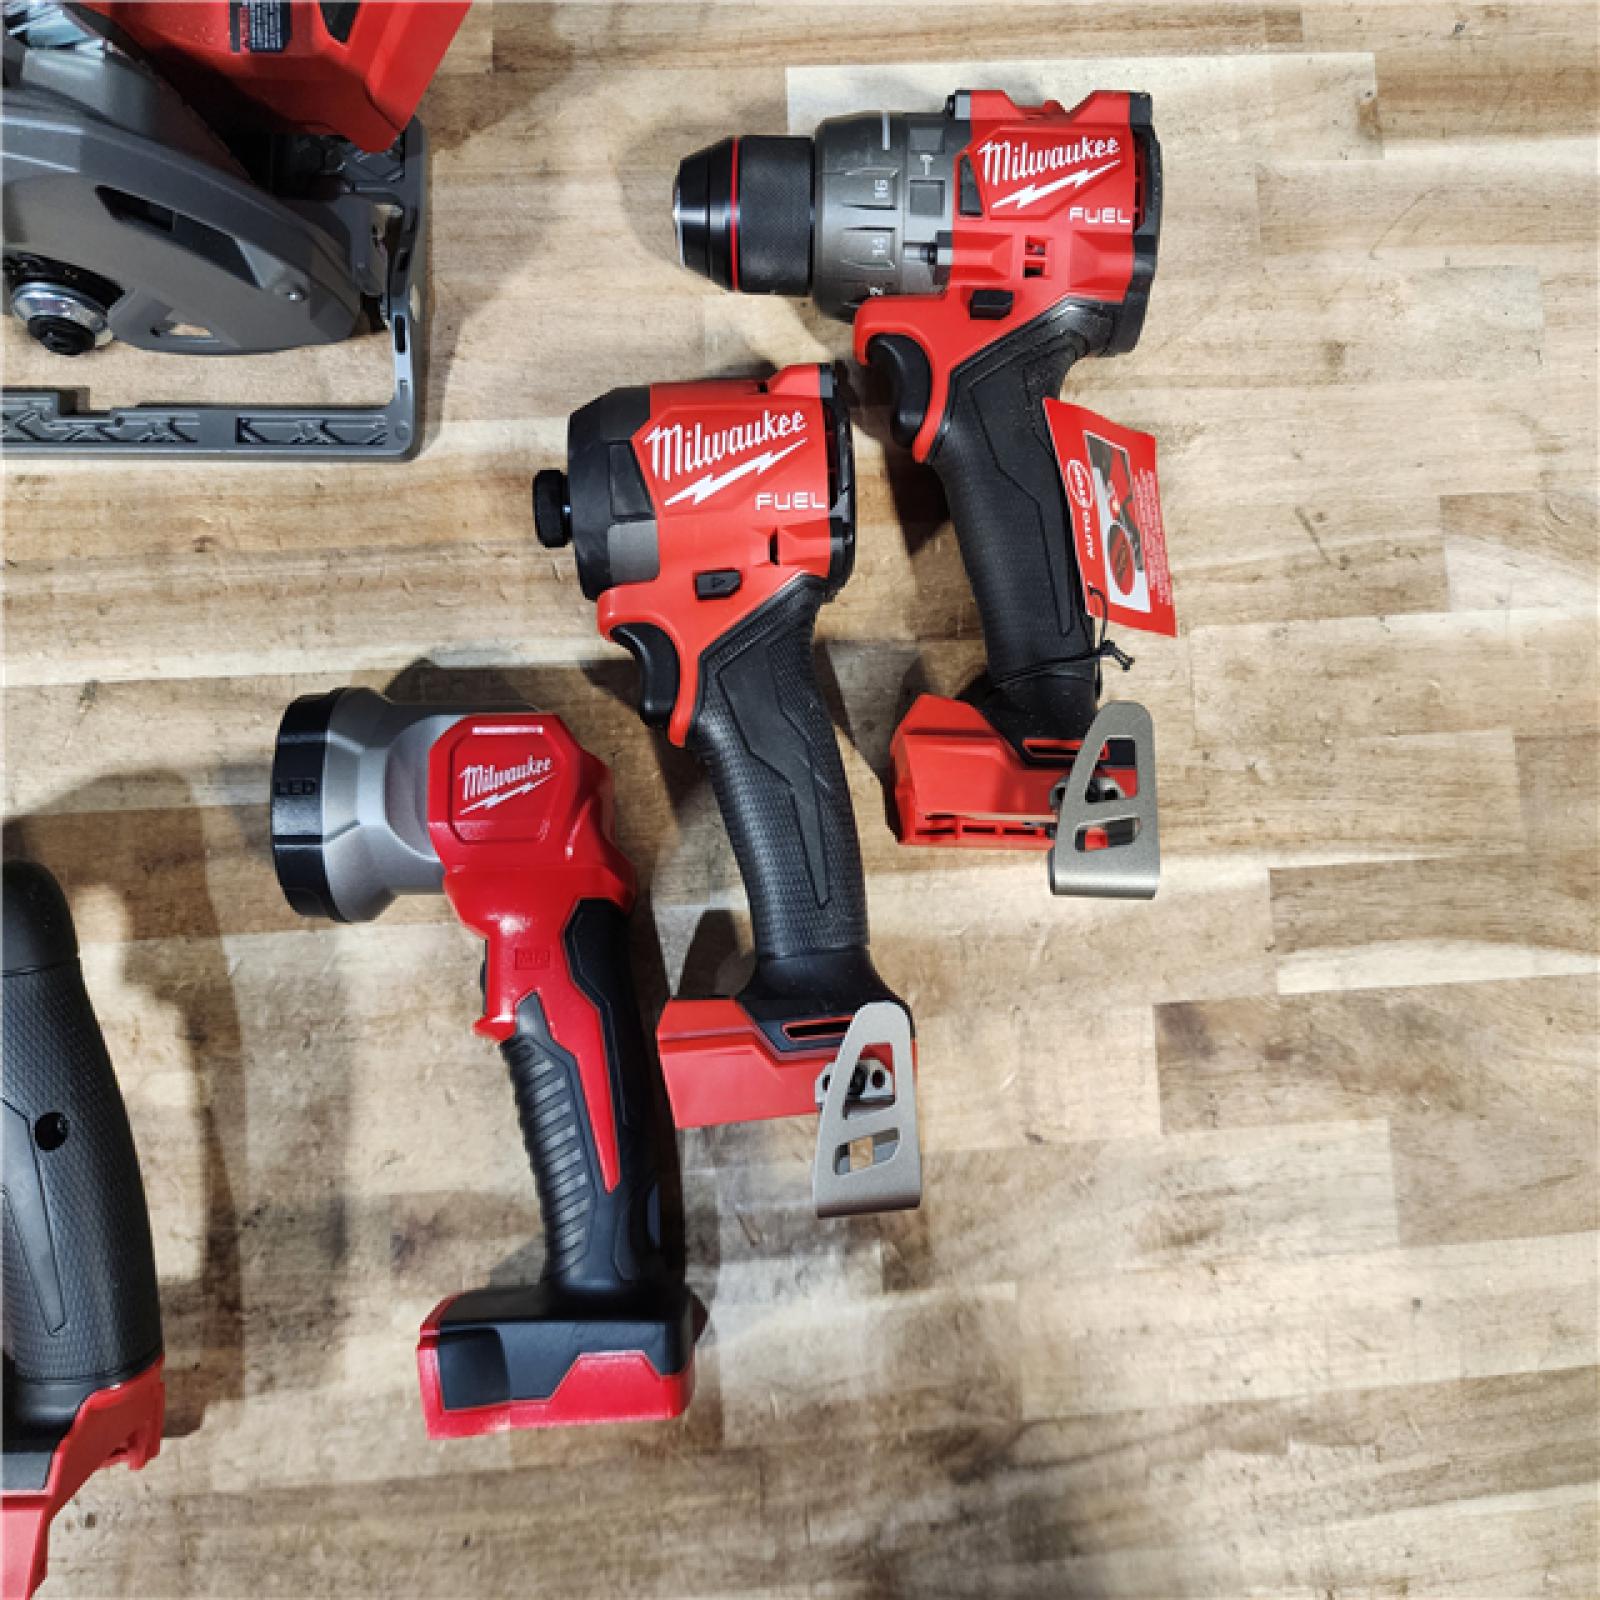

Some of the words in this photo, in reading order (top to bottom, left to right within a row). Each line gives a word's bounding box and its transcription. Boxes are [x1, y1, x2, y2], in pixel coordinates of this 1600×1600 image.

[978, 136, 1120, 186] Milwaukee
[1069, 207, 1131, 224] FUEL
[644, 410, 807, 481] Milwaukee
[755, 492, 826, 511] FUEL
[275, 777, 316, 796] LED
[459, 754, 553, 801] Milwaukee
